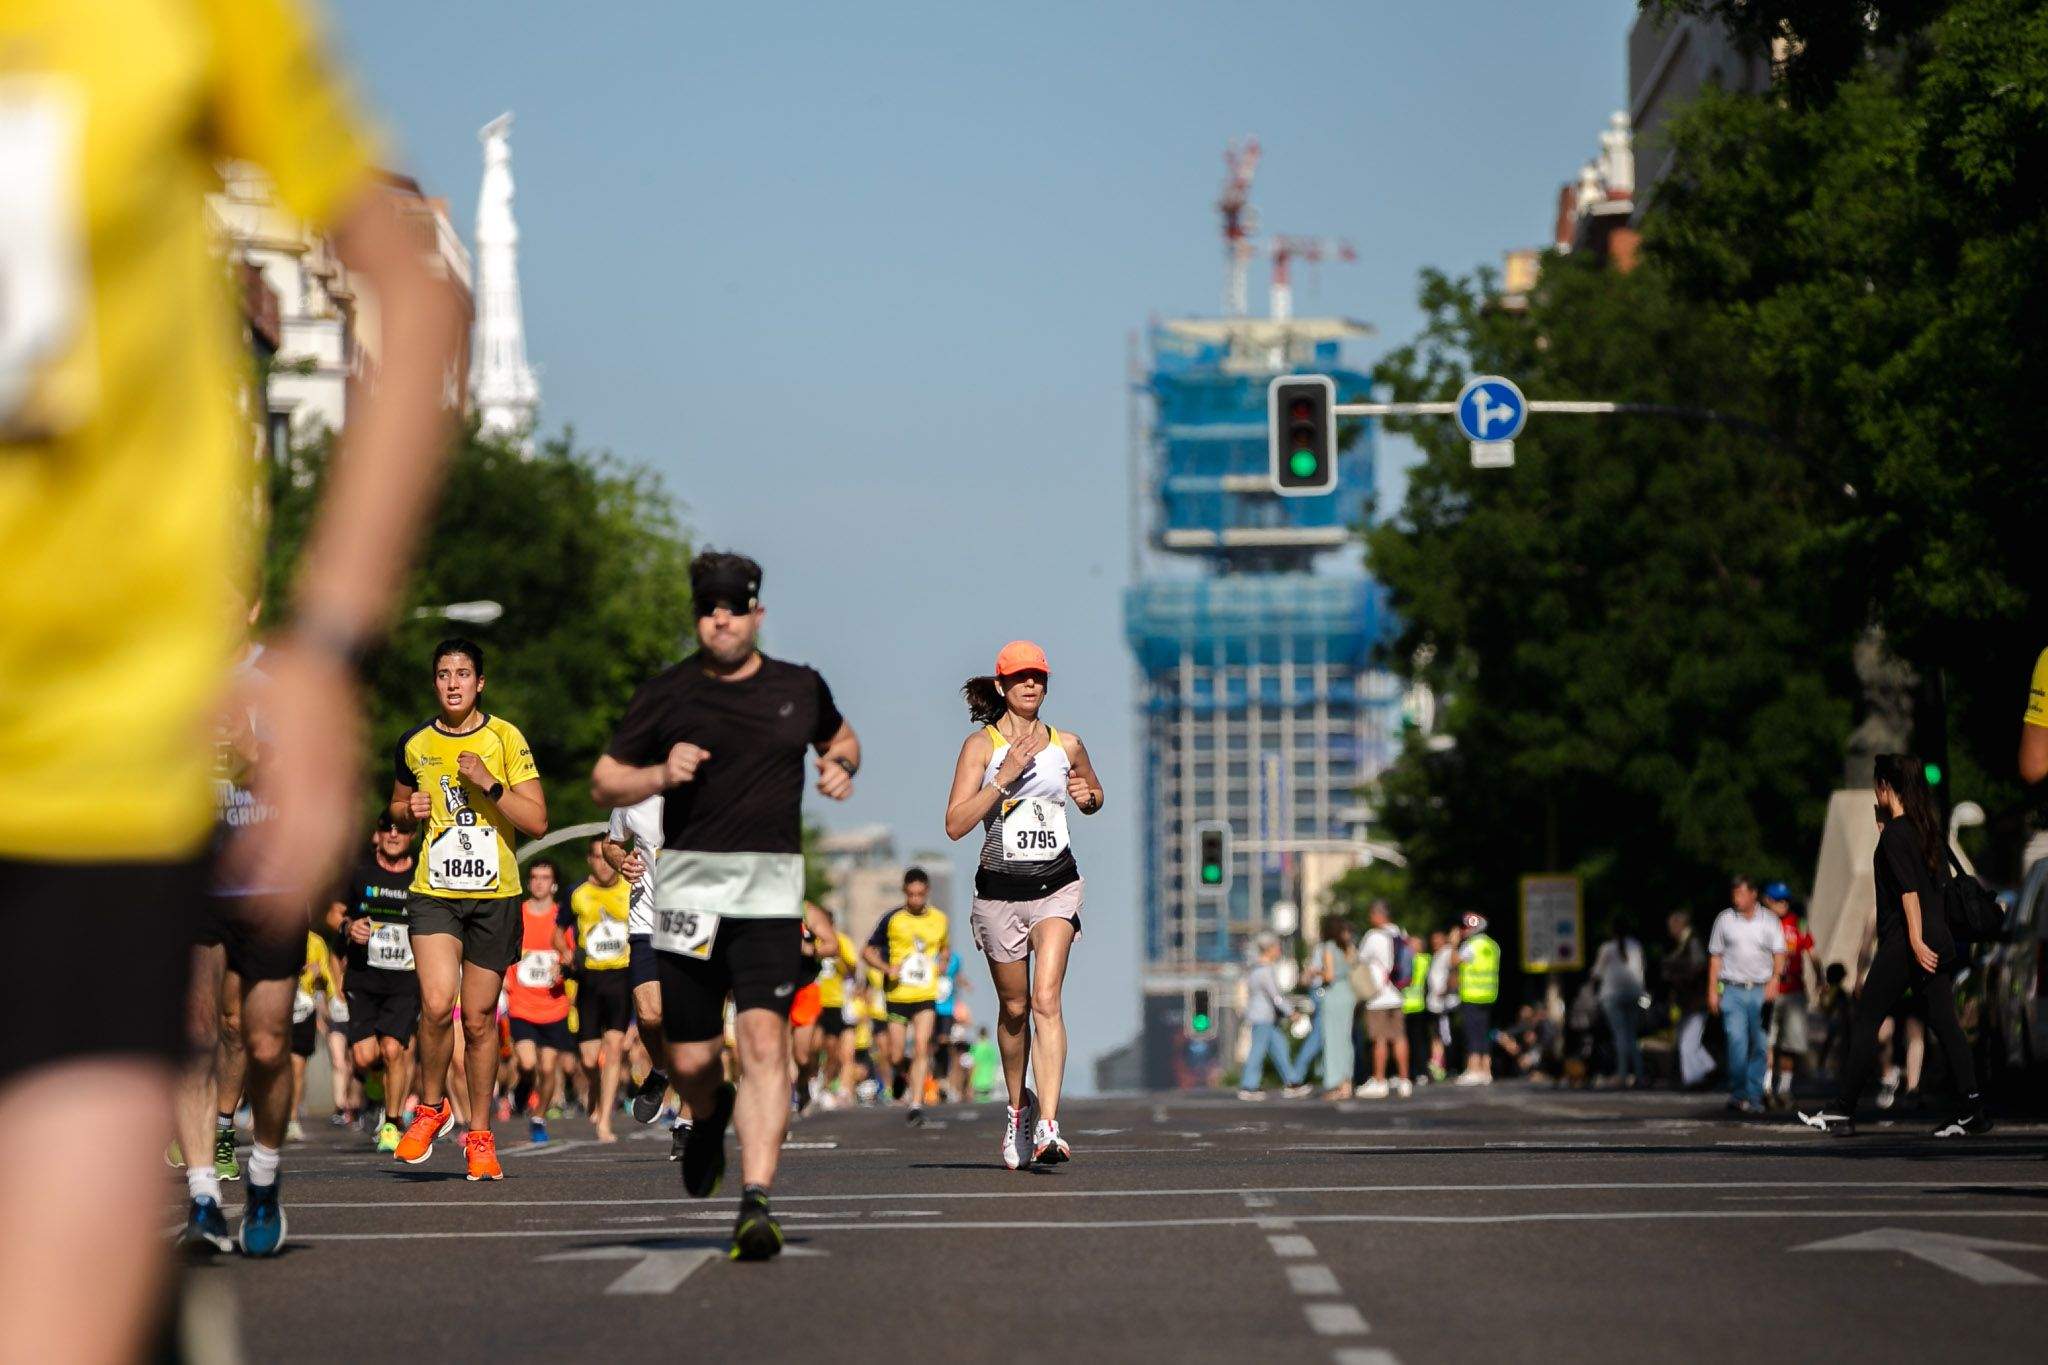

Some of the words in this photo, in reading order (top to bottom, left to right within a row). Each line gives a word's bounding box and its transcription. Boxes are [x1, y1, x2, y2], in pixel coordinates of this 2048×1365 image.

[460, 812, 474, 825] 13
[1017, 830, 1057, 849] 3795
[443, 859, 484, 878] 1848
[380, 946, 405, 960] 1344
